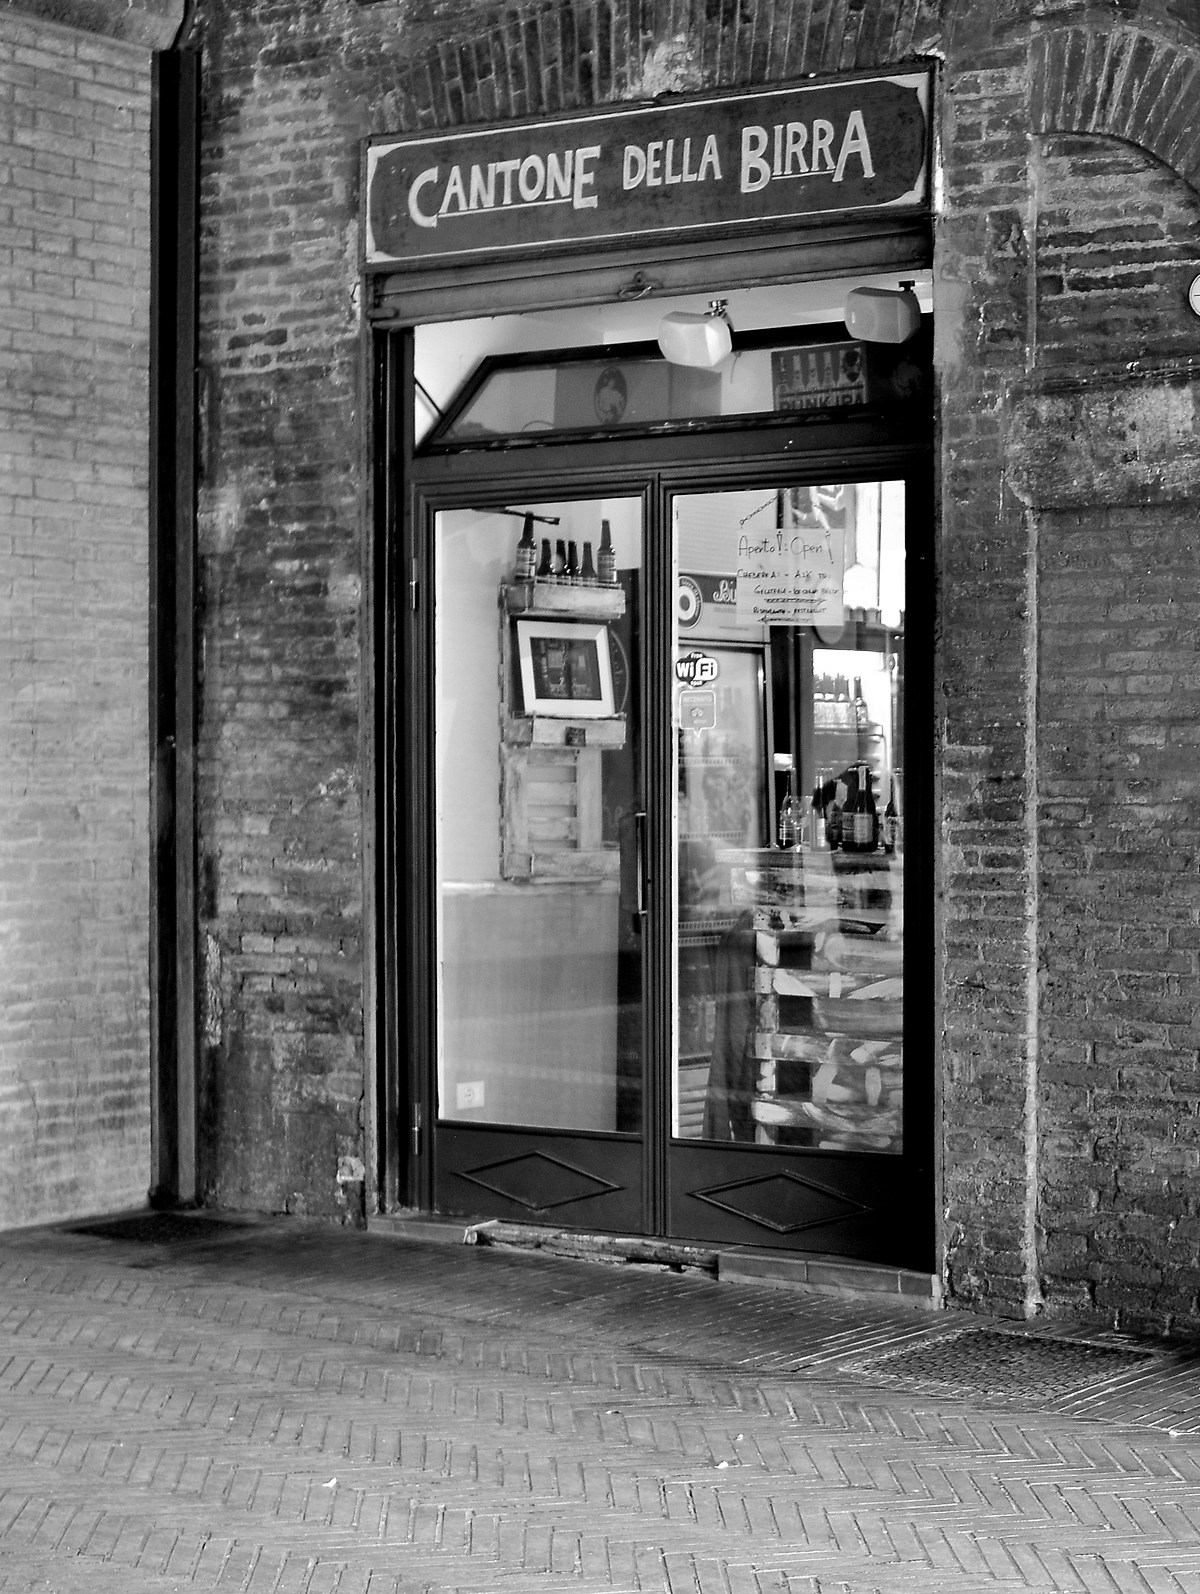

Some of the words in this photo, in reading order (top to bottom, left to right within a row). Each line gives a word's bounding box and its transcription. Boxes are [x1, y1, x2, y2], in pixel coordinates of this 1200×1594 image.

[408, 146, 600, 228] CANTONE
[623, 134, 722, 190] DELLA
[740, 110, 876, 193] BIRRA
